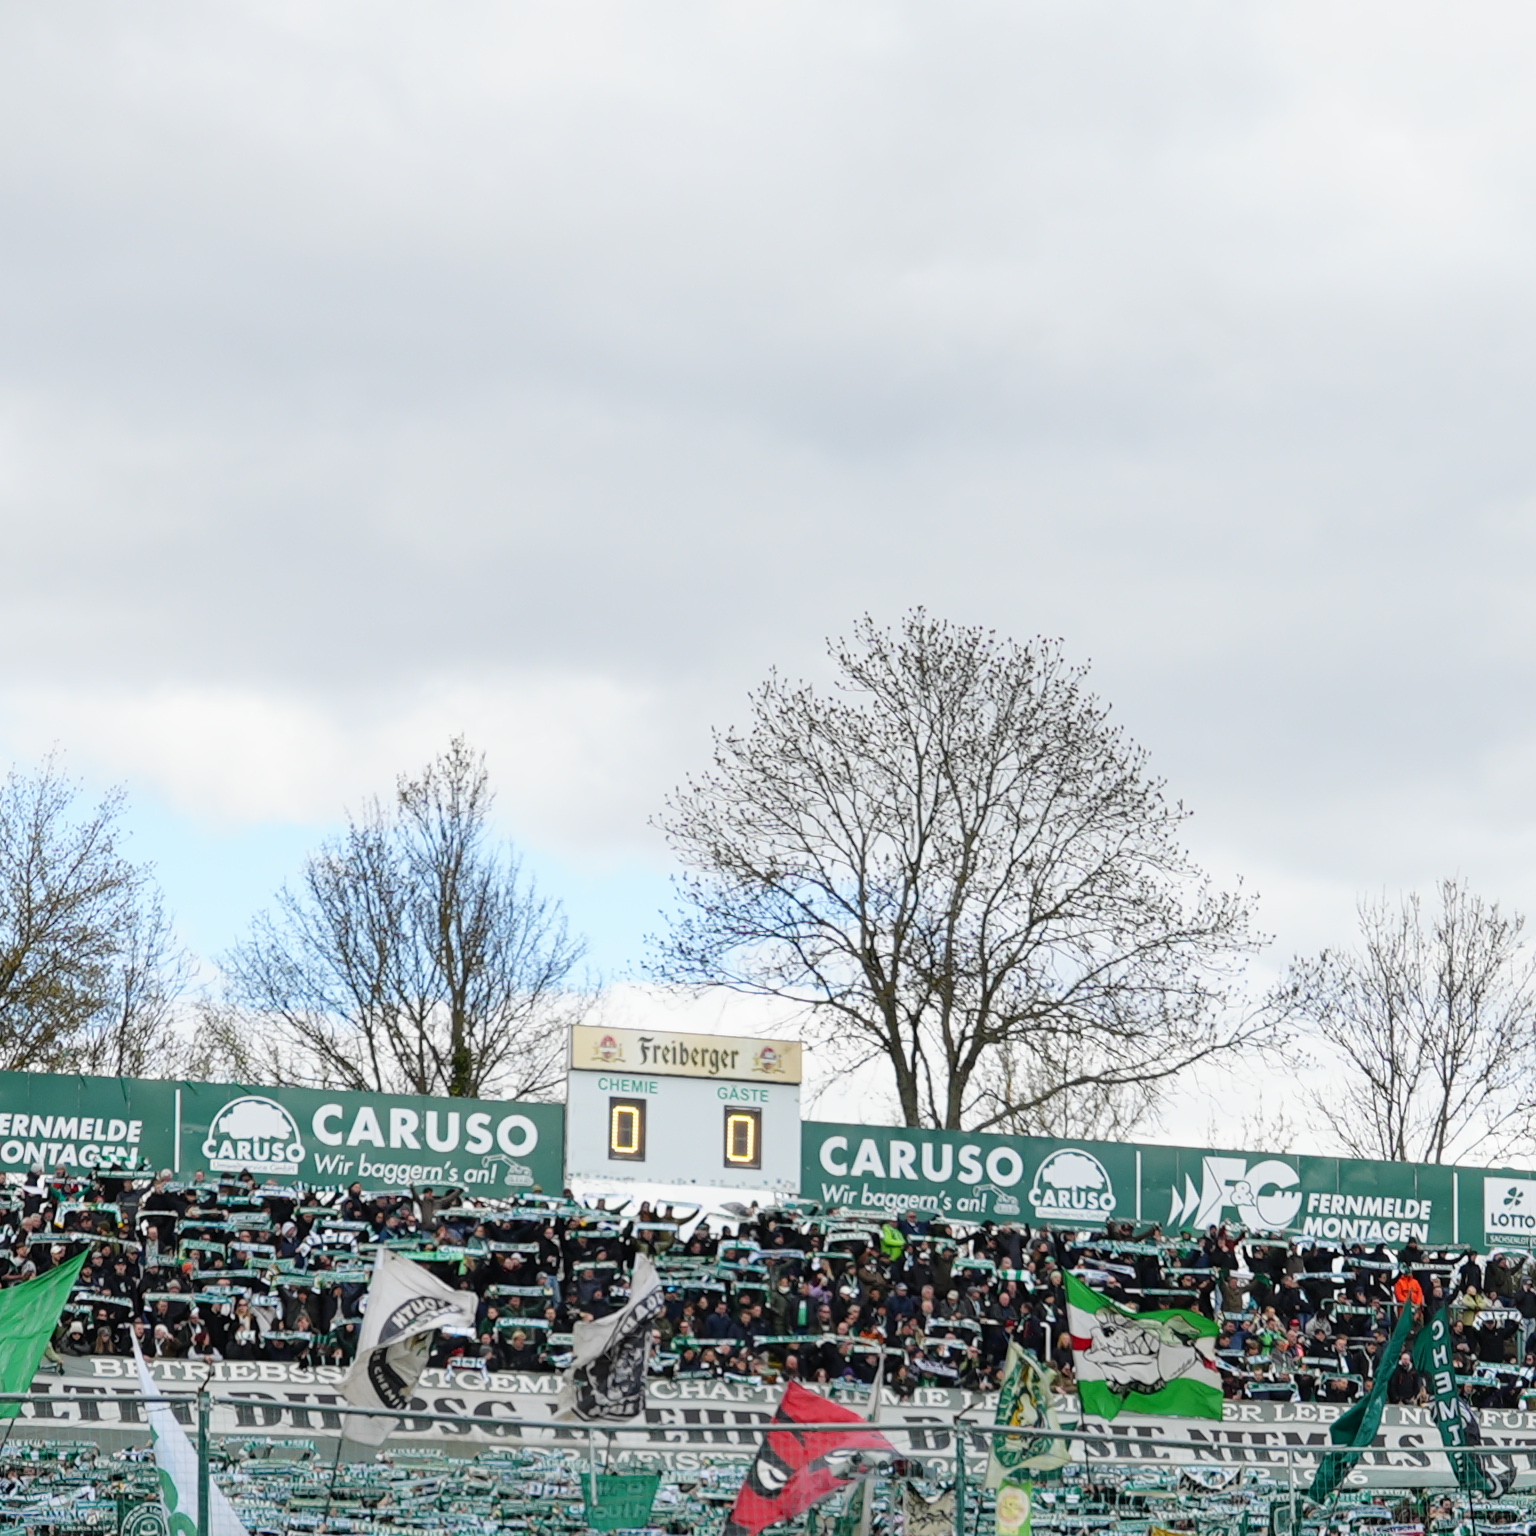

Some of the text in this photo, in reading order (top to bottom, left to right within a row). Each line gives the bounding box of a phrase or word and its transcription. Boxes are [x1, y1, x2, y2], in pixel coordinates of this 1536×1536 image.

[638, 1037, 740, 1075] Freiberger
[598, 1077, 658, 1094] CHEMIE
[717, 1085, 769, 1102] GÄSTE
[311, 1103, 539, 1158] CARUSO
[610, 1104, 641, 1154] 0
[725, 1113, 755, 1164] 0
[201, 1139, 306, 1164] CARUSO
[819, 1135, 1024, 1186] CARUSO
[314, 1153, 498, 1187] Wir baggern's an!
[821, 1182, 988, 1214] Wir baggern's an!
[1028, 1186, 1116, 1211] CARUSO
[1307, 1193, 1432, 1221] FERNMELDE
[1303, 1216, 1429, 1244] MONTAGEN
[1490, 1212, 1536, 1229] LOTTO
